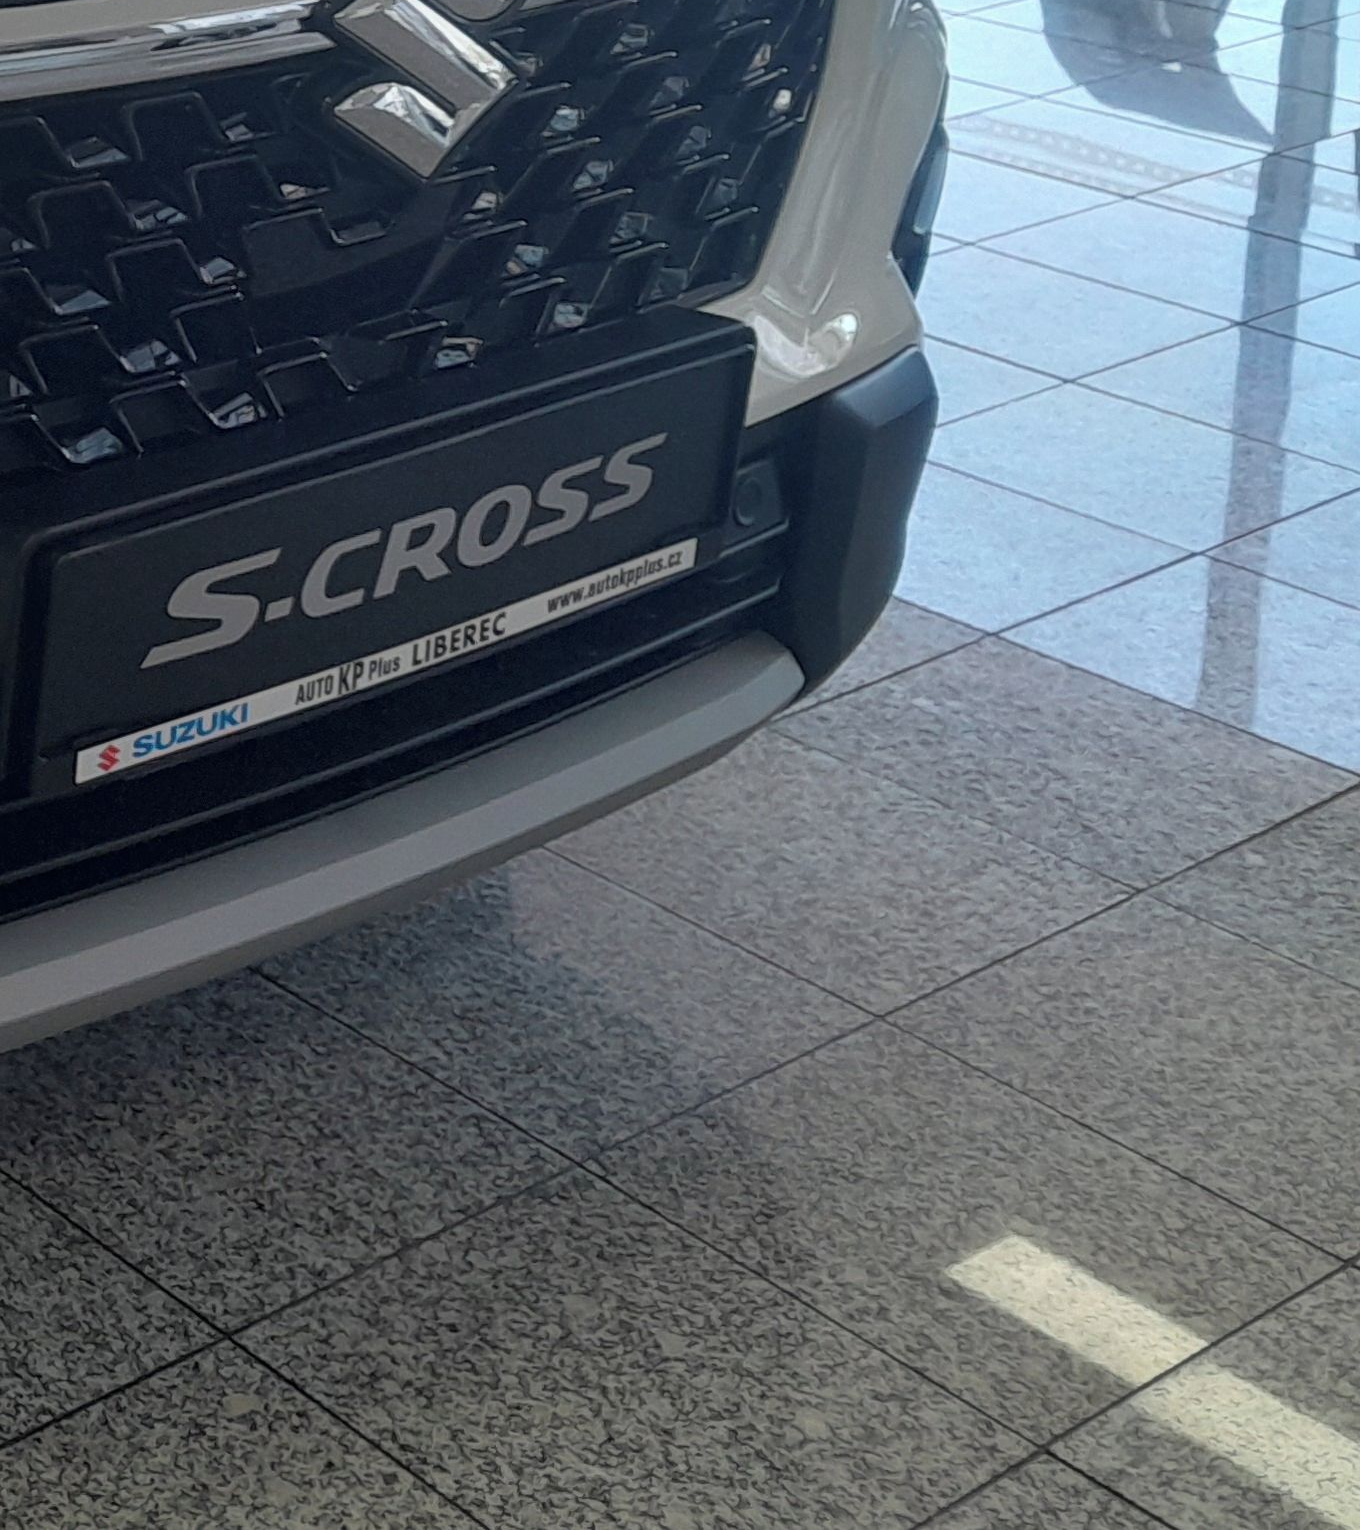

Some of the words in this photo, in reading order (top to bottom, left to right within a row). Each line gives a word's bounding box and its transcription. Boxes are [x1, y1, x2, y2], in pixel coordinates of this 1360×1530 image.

[132, 702, 249, 758] SUZUKI
[295, 674, 334, 706] AUTO
[337, 660, 365, 697] KP
[368, 654, 401, 681] Plus
[411, 611, 507, 668] LIBEREC
[546, 548, 684, 614] www.autokpplus.cz
